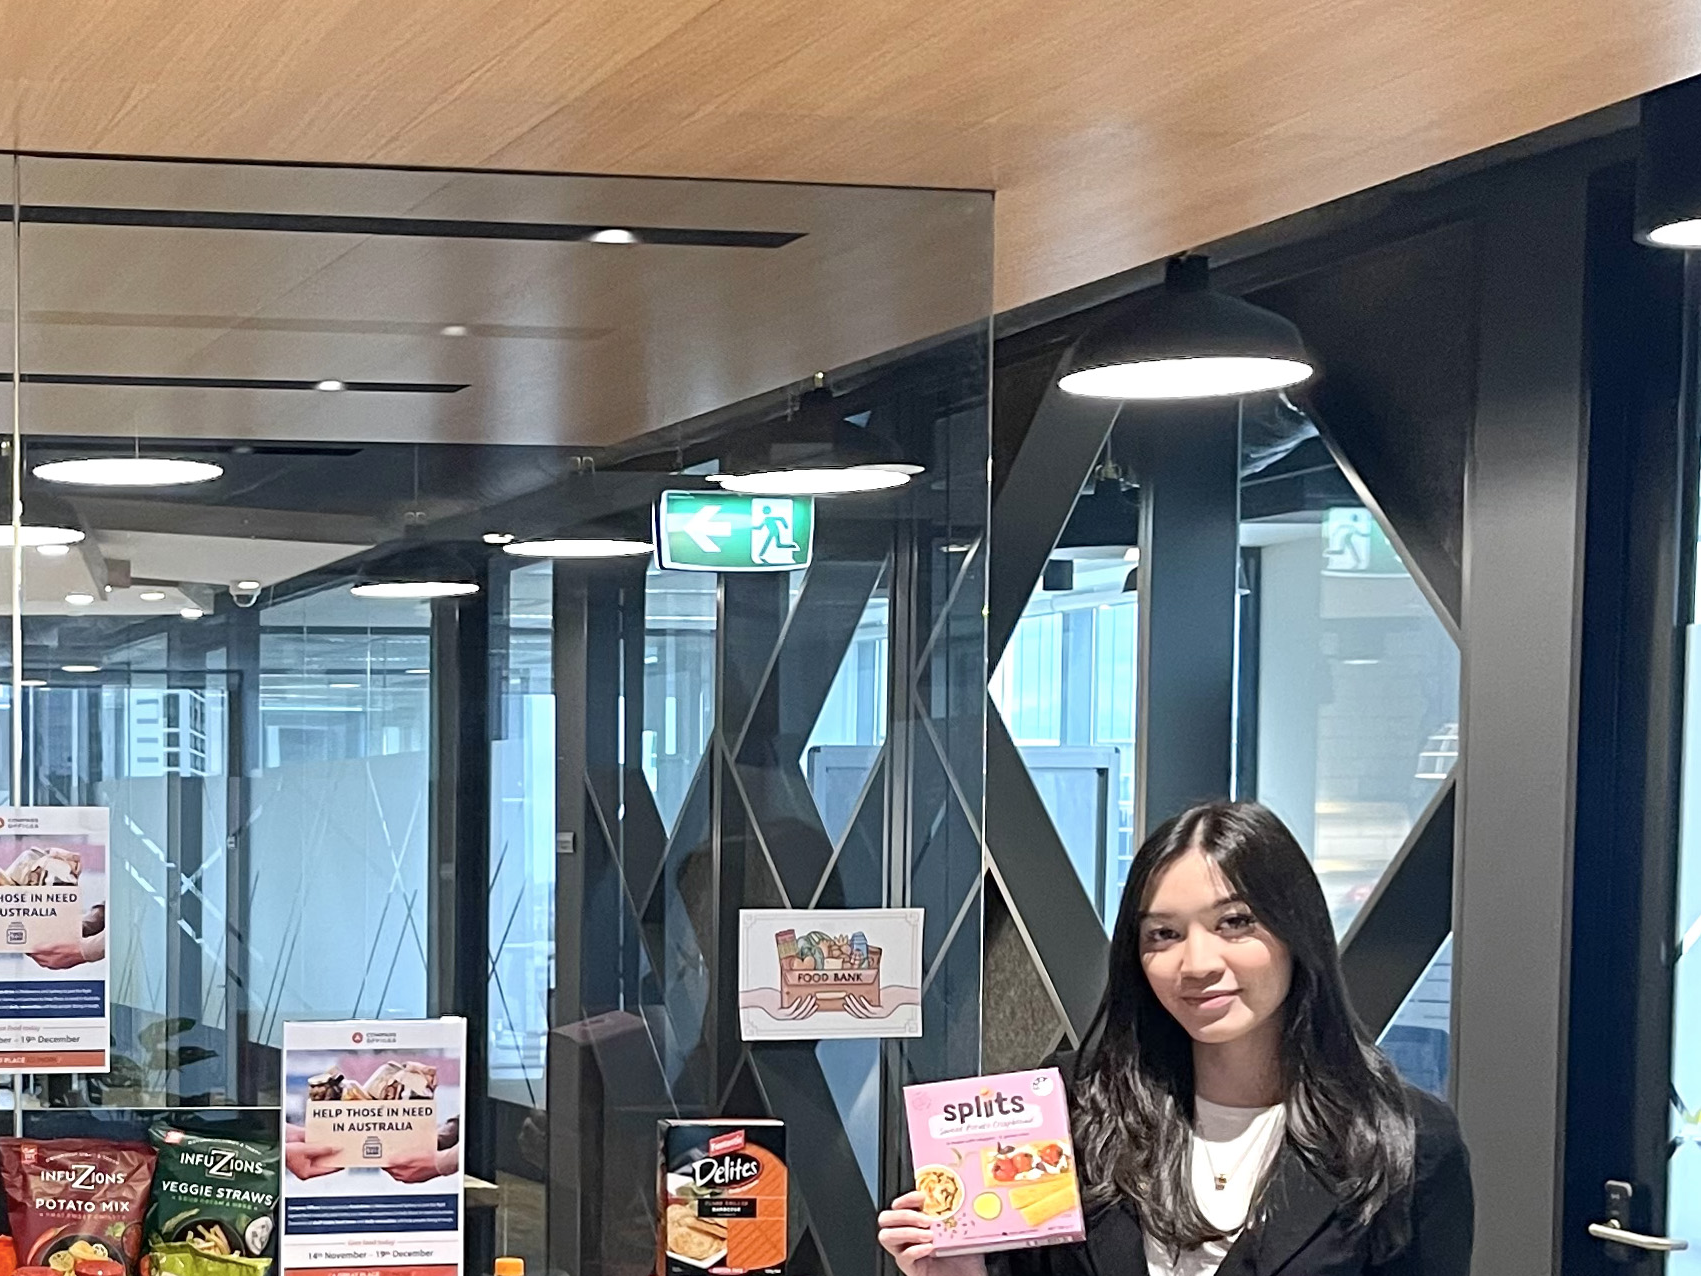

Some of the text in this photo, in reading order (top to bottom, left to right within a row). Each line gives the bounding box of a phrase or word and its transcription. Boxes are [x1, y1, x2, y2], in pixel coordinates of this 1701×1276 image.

[31, 894, 42, 902] IN
[47, 894, 77, 902] NEED
[798, 973, 863, 982] FOOD BANK
[313, 1107, 433, 1118] HELP THOSE IN NEED
[943, 1088, 1024, 1124] splits
[333, 1122, 413, 1131] IN AUSTRALIA
[180, 1150, 263, 1176] INFUZIONS
[41, 1165, 125, 1189] INFUZIONS
[692, 1156, 757, 1187] Delites
[162, 1181, 273, 1206] VEGGIE STRAWS
[36, 1198, 130, 1212] POTATO MIX
[325, 1251, 366, 1259] November
